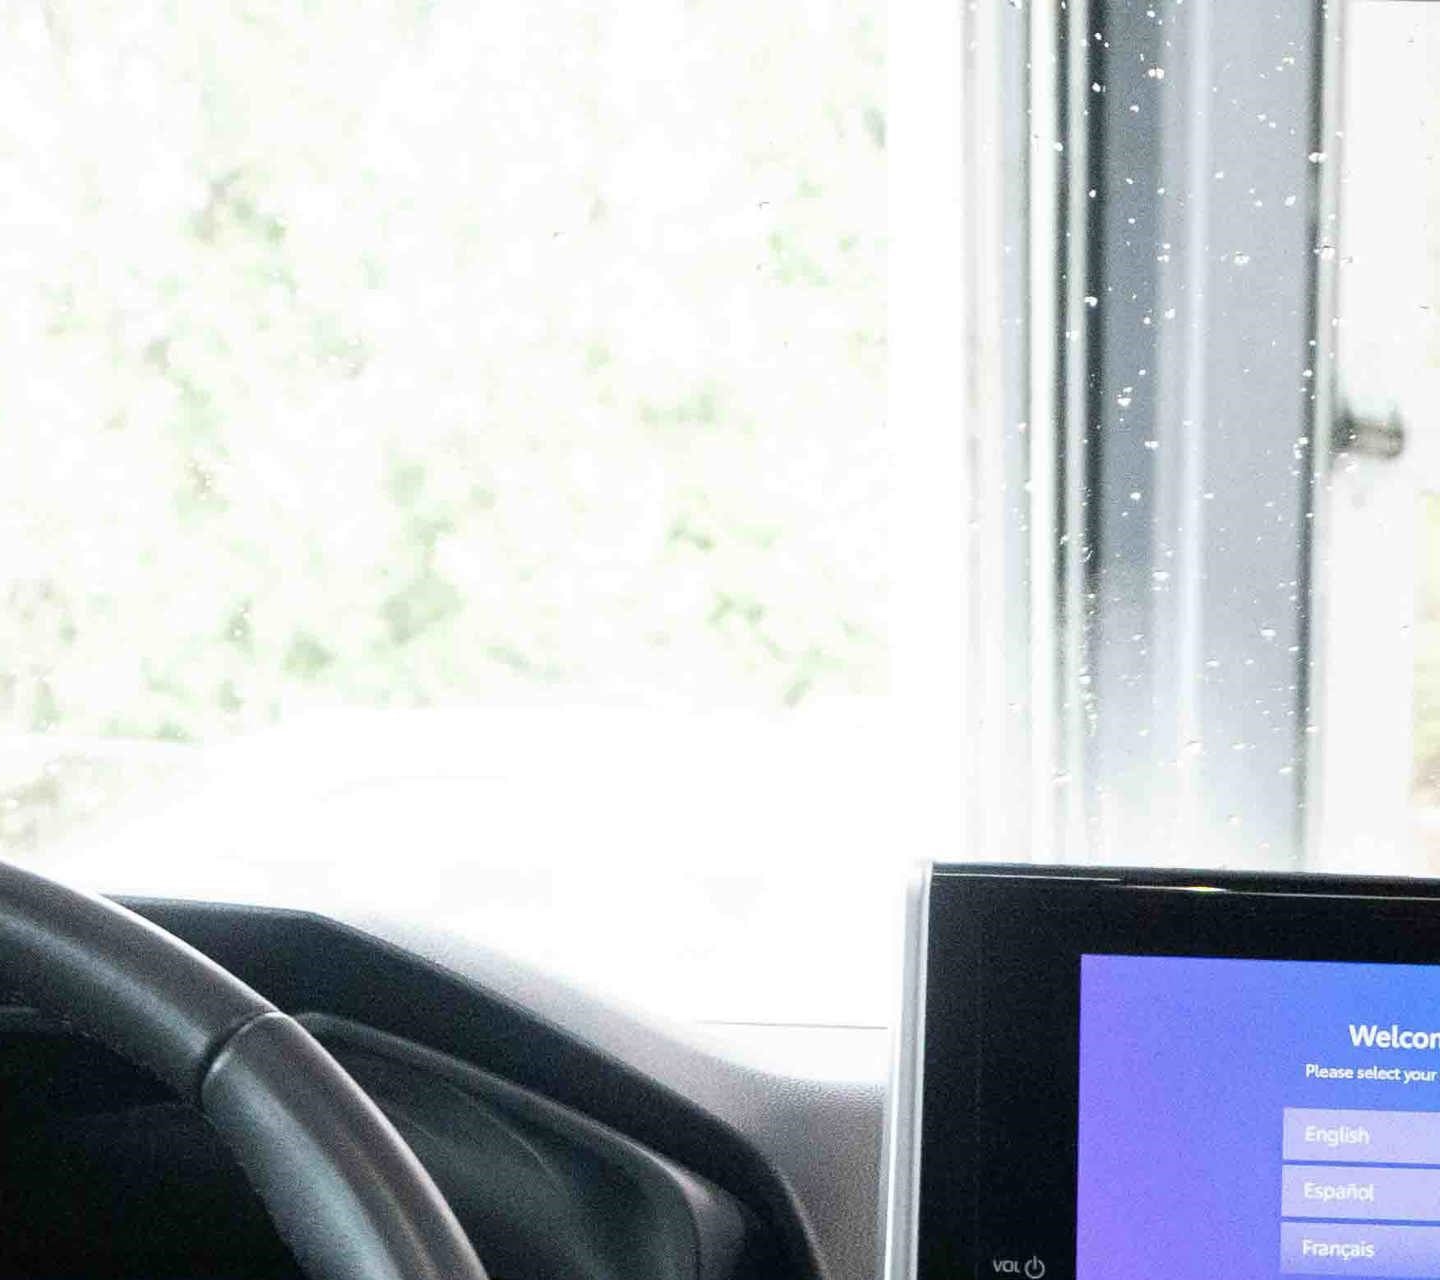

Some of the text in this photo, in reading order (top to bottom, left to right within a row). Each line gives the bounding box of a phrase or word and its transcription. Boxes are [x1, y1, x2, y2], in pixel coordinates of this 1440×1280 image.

[1305, 1063, 1354, 1080] Please
[1357, 1065, 1401, 1081] select
[1403, 1068, 1437, 1084] your
[1304, 1126, 1371, 1148] English
[1303, 1182, 1375, 1203] Español
[1302, 1239, 1376, 1261] Français
[992, 1259, 1021, 1274] VOL
